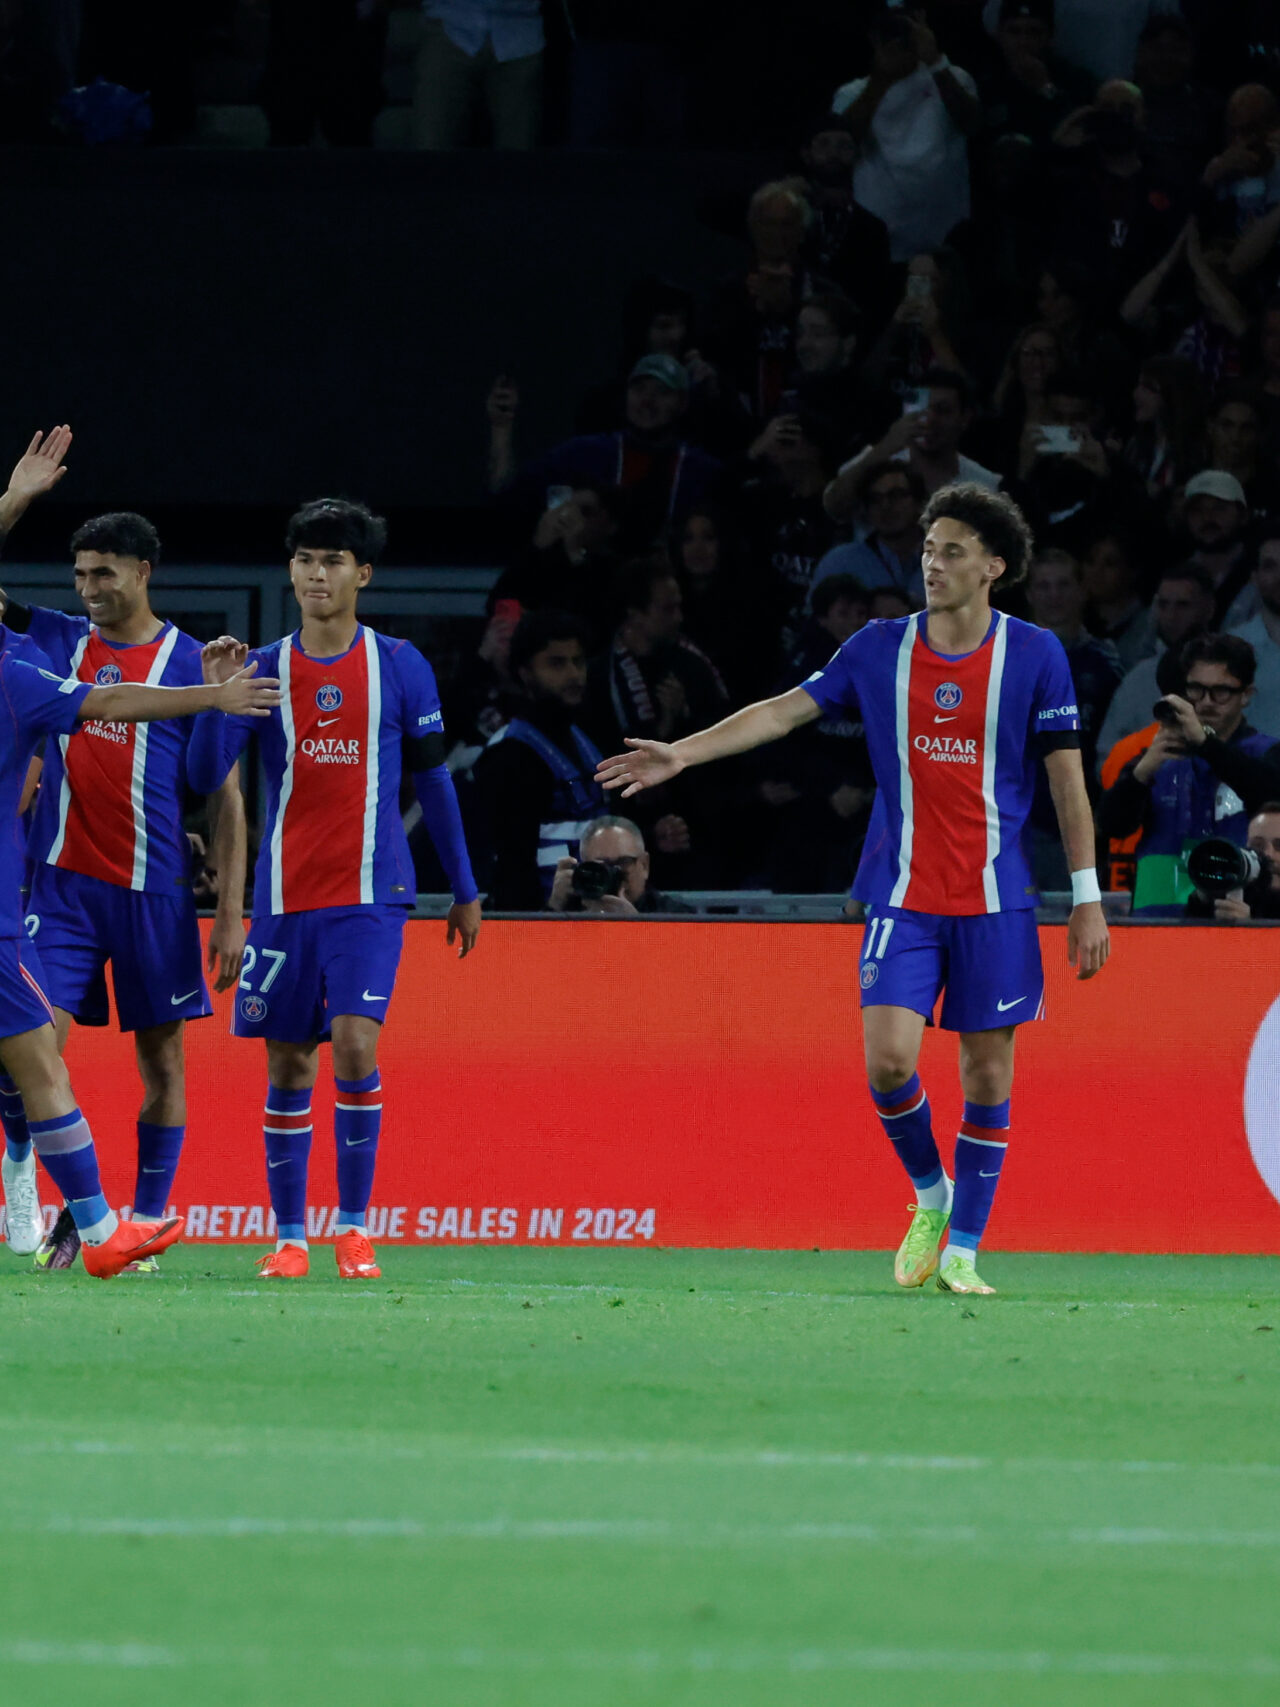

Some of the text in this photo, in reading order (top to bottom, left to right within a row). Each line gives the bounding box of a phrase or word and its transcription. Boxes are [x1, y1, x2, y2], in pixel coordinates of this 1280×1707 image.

[1038, 705, 1078, 719] BEYON
[84, 724, 128, 745] AIRWAYS
[301, 738, 360, 757] QATAR
[914, 735, 977, 754] QATAR
[314, 754, 360, 765] AIRWAYS
[929, 752, 977, 765] AIRWAYS
[864, 917, 895, 960] 11
[238, 944, 287, 993] 27
[185, 1206, 277, 1238] RETAI
[306, 1207, 407, 1238] VAUE
[416, 1207, 518, 1239] SALES
[528, 1208, 564, 1239] IN
[572, 1208, 656, 1240] 2024
